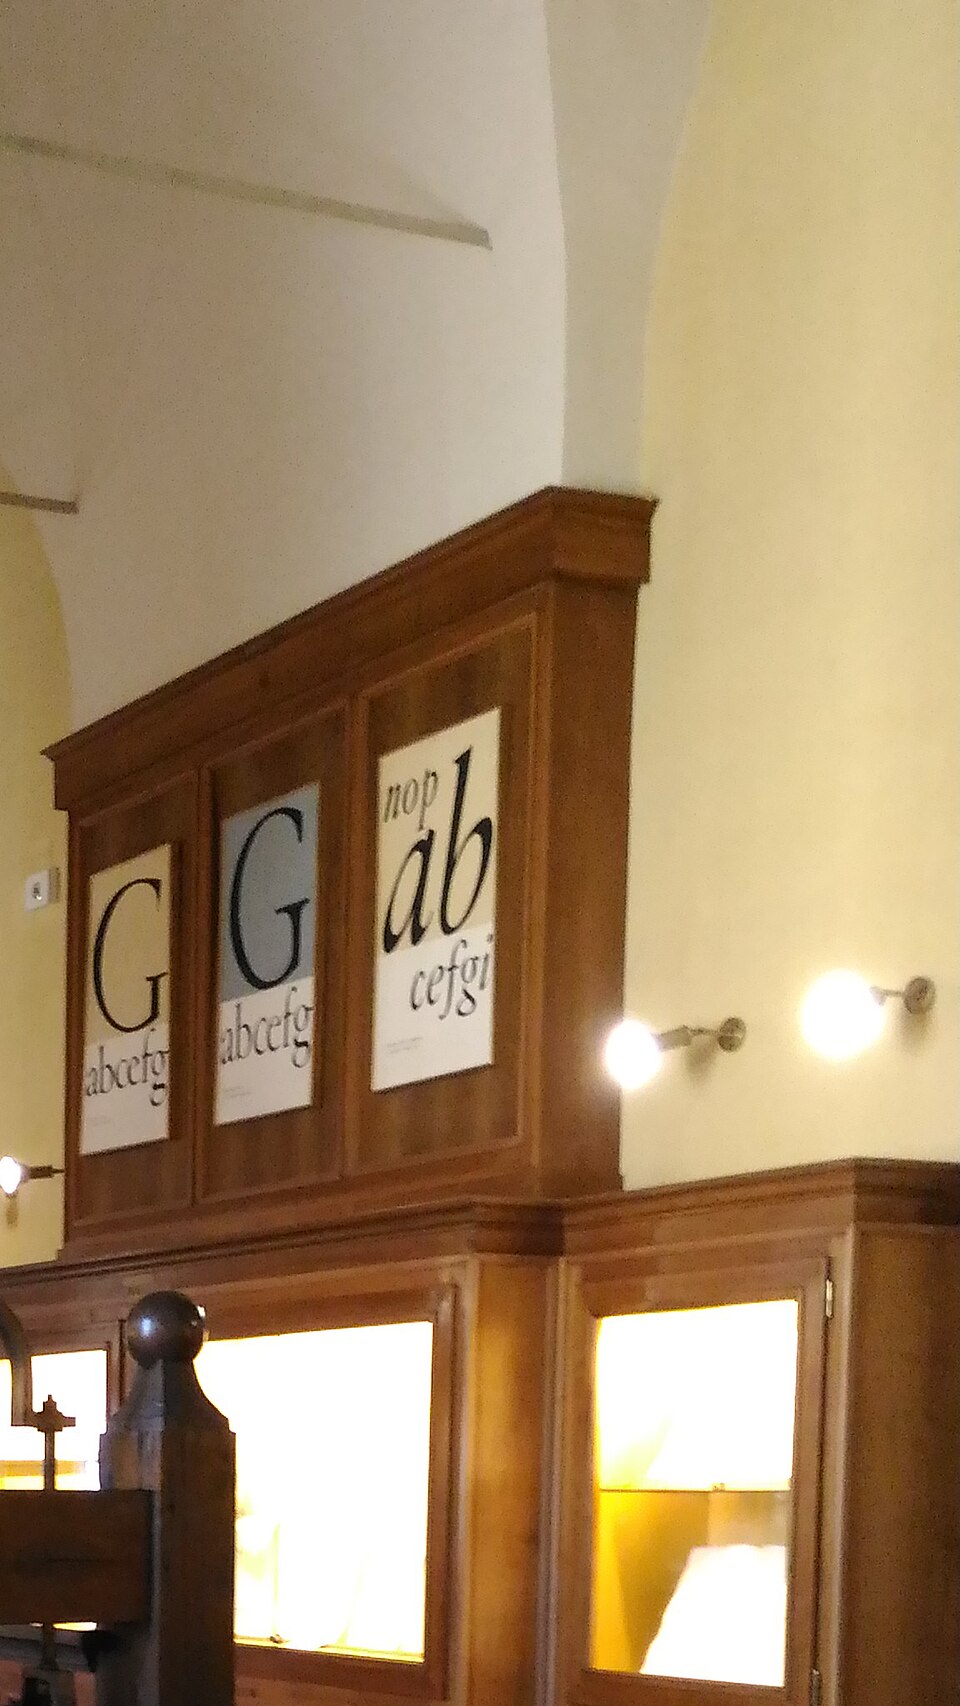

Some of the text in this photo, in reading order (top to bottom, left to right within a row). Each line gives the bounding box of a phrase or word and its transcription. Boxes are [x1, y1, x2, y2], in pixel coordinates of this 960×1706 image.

[383, 745, 493, 953] ab
[384, 769, 438, 831] nop
[93, 877, 168, 1033] G
[227, 806, 310, 990] G
